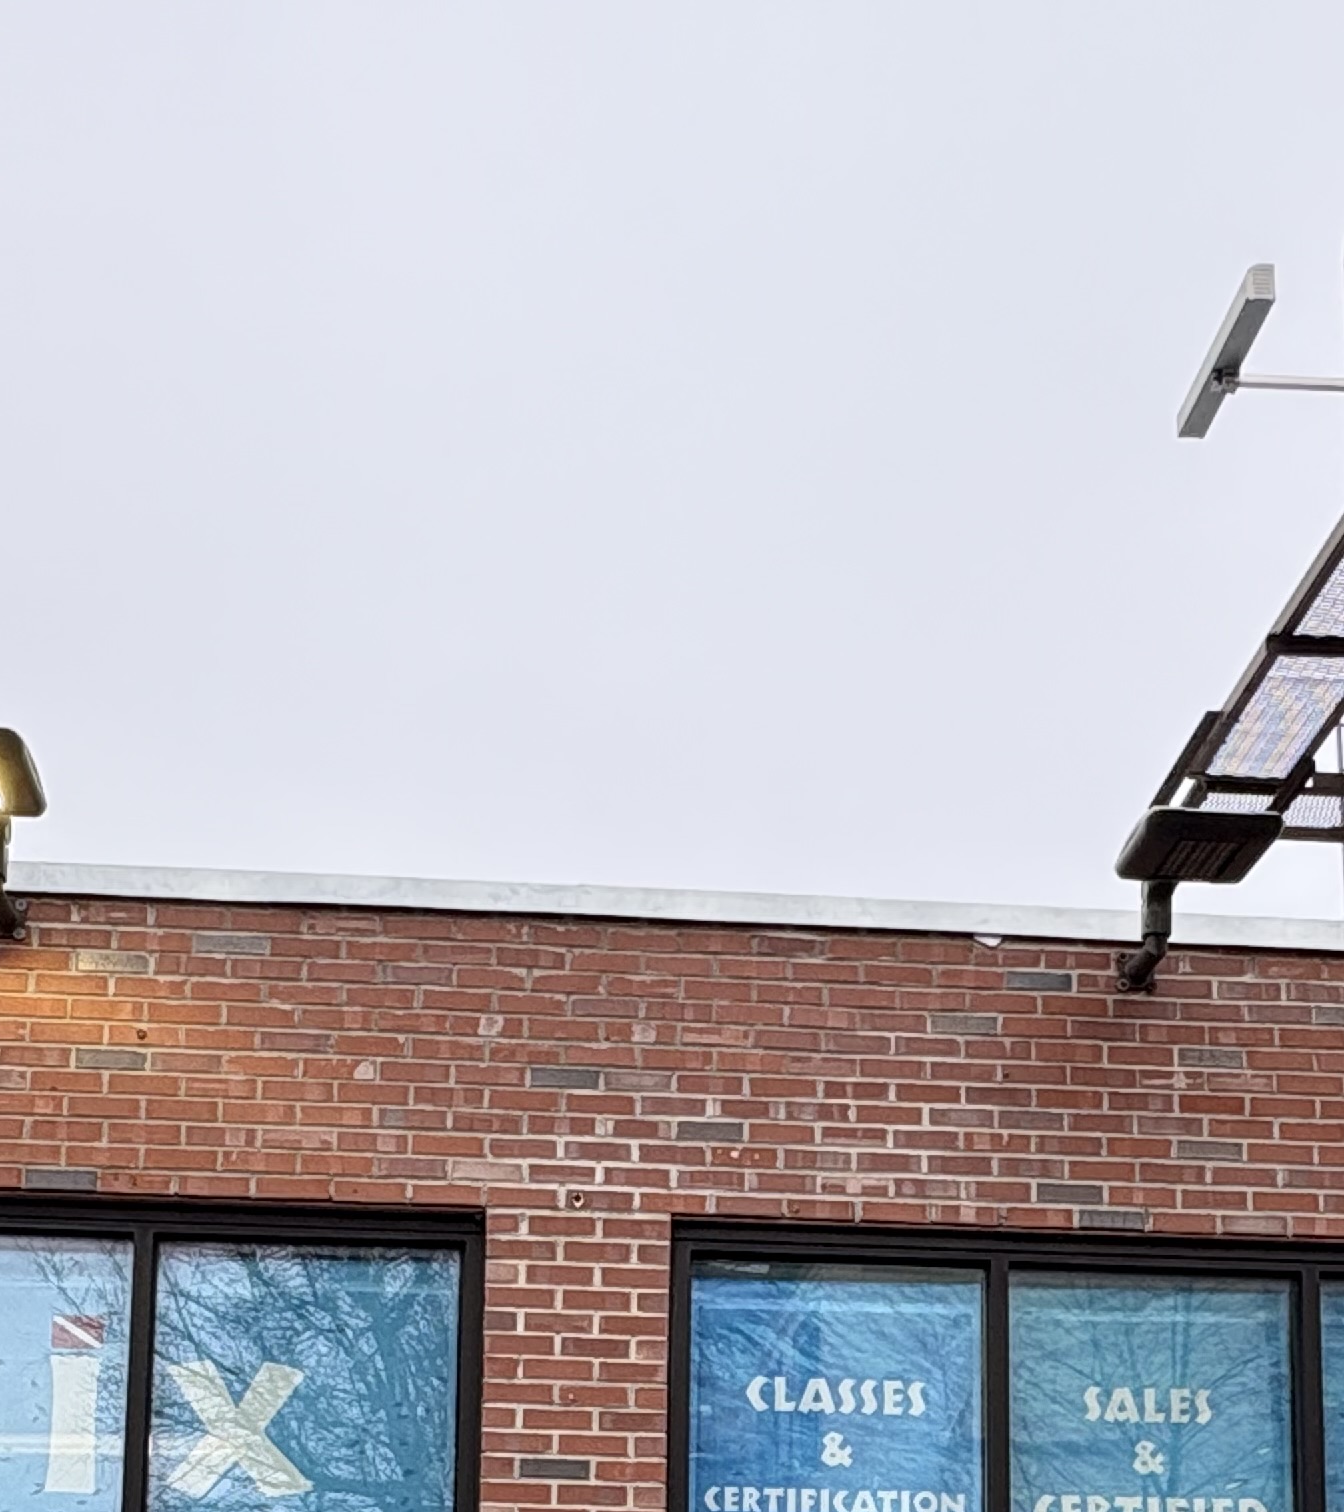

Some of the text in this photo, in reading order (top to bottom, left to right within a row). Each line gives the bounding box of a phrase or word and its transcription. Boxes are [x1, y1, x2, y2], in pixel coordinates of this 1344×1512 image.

[746, 1376, 927, 1417] CLASSES
[1082, 1386, 1213, 1425] SALES
[821, 1431, 853, 1468] &
[1132, 1440, 1165, 1475] &
